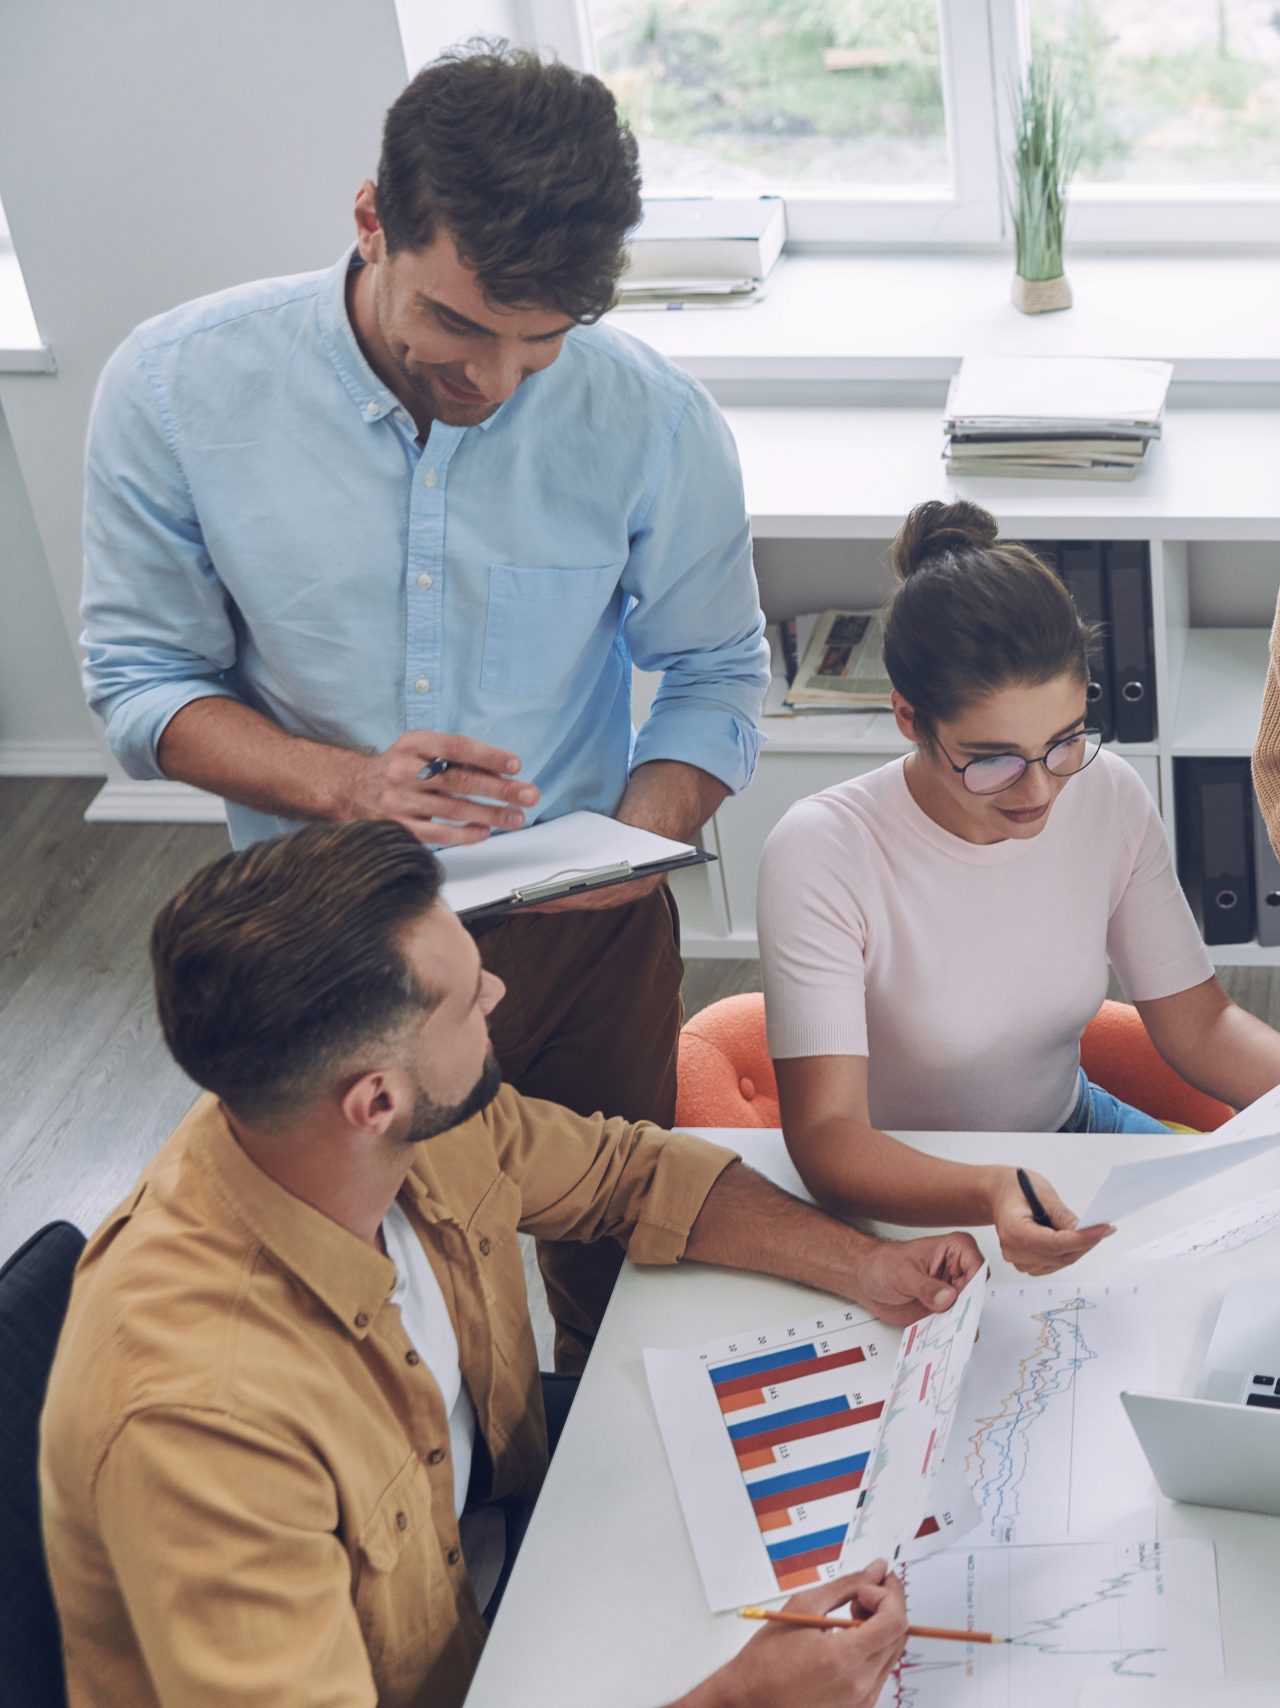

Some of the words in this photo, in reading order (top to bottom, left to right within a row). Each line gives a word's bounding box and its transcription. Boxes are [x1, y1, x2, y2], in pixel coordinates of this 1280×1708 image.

[728, 1343, 738, 1353] 10
[757, 1335, 767, 1344] 20
[786, 1327, 796, 1337] 30
[815, 1320, 825, 1329] 40
[843, 1312, 853, 1321] 50
